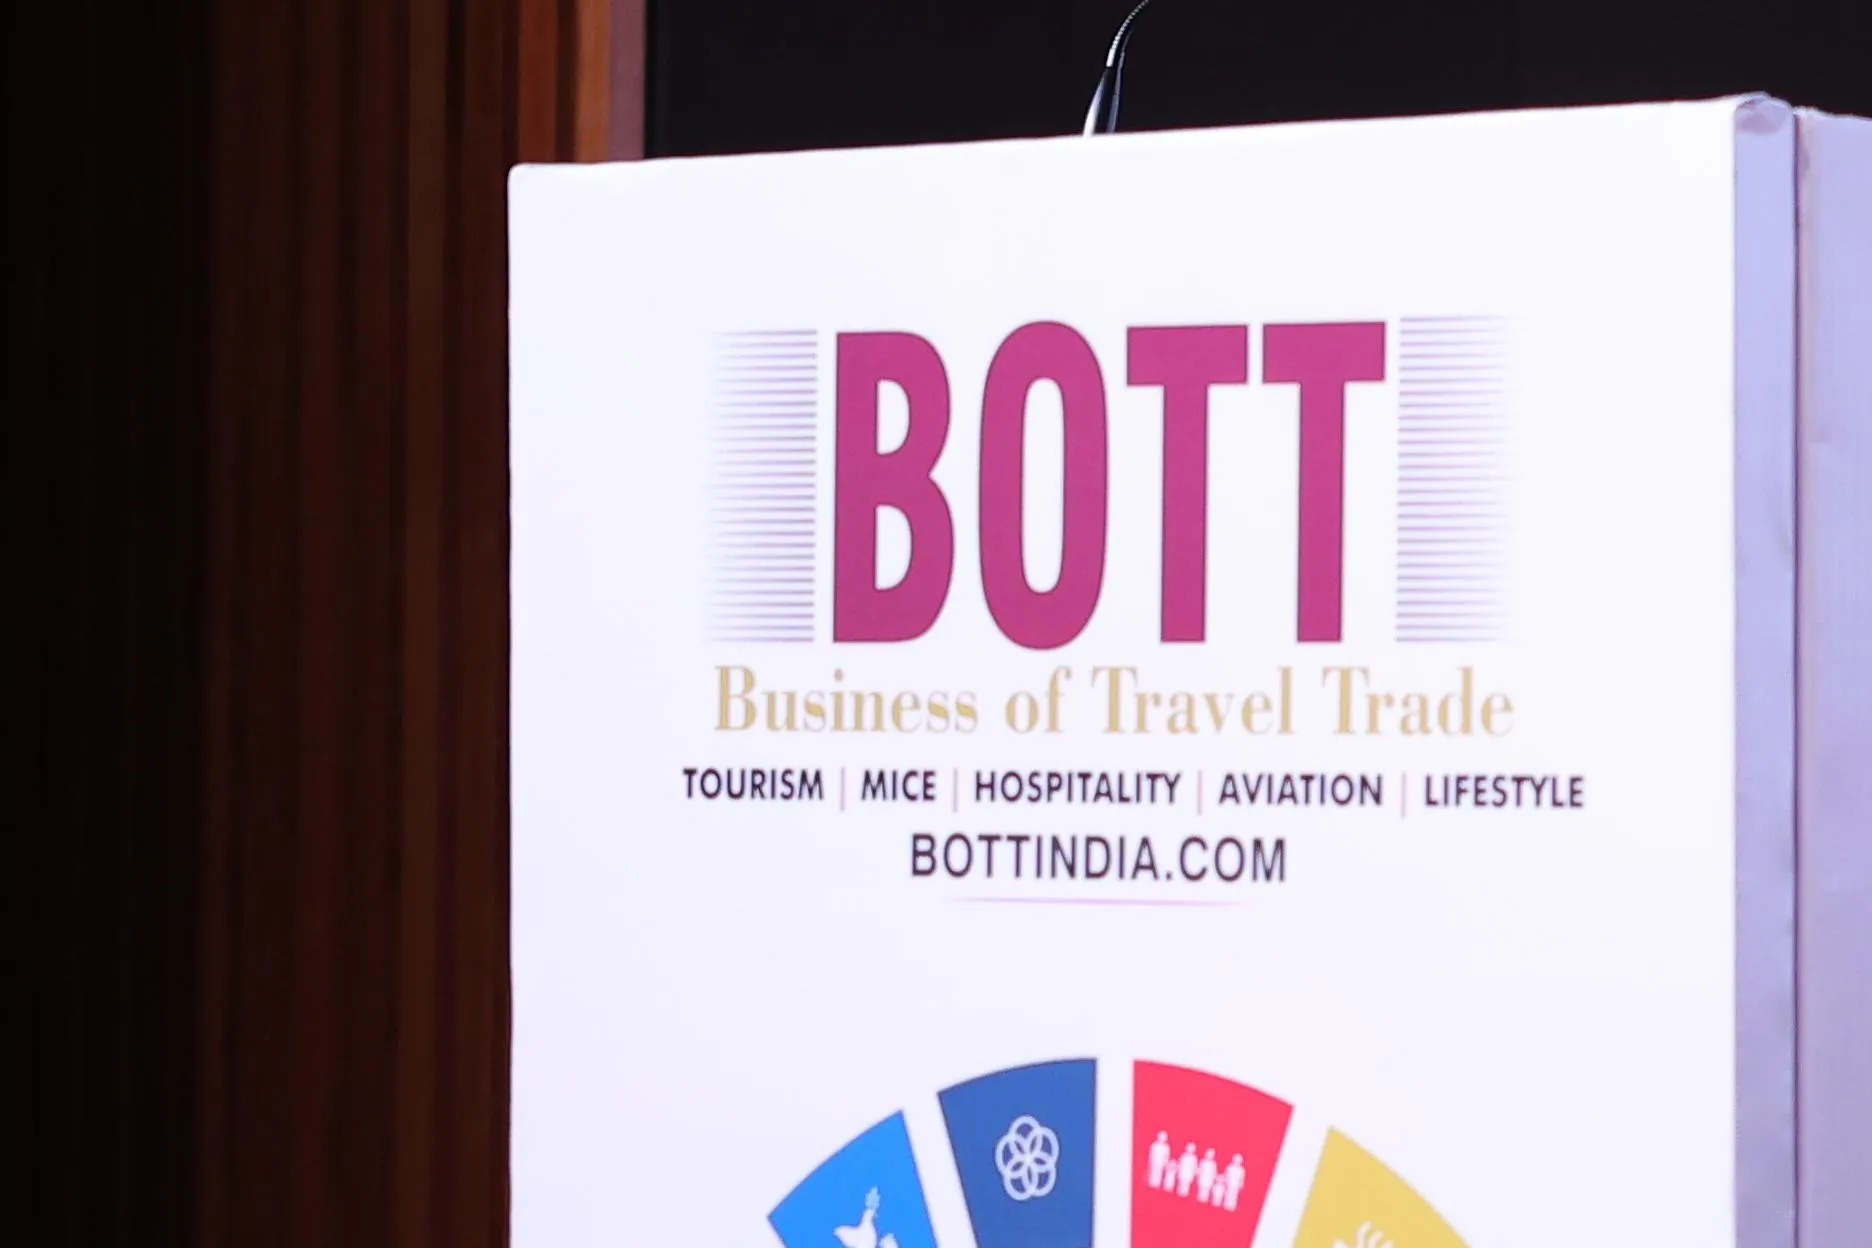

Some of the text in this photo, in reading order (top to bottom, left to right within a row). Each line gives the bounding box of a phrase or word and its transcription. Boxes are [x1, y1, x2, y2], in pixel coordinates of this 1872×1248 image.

[832, 320, 1387, 651] BOTT
[713, 665, 1514, 737] Business of Travel Trade
[682, 767, 1585, 809] TOURISM MICE HOSPITALITY AVIATION LIFESTYLE
[910, 832, 1287, 883] BOTTINDIA.COM
